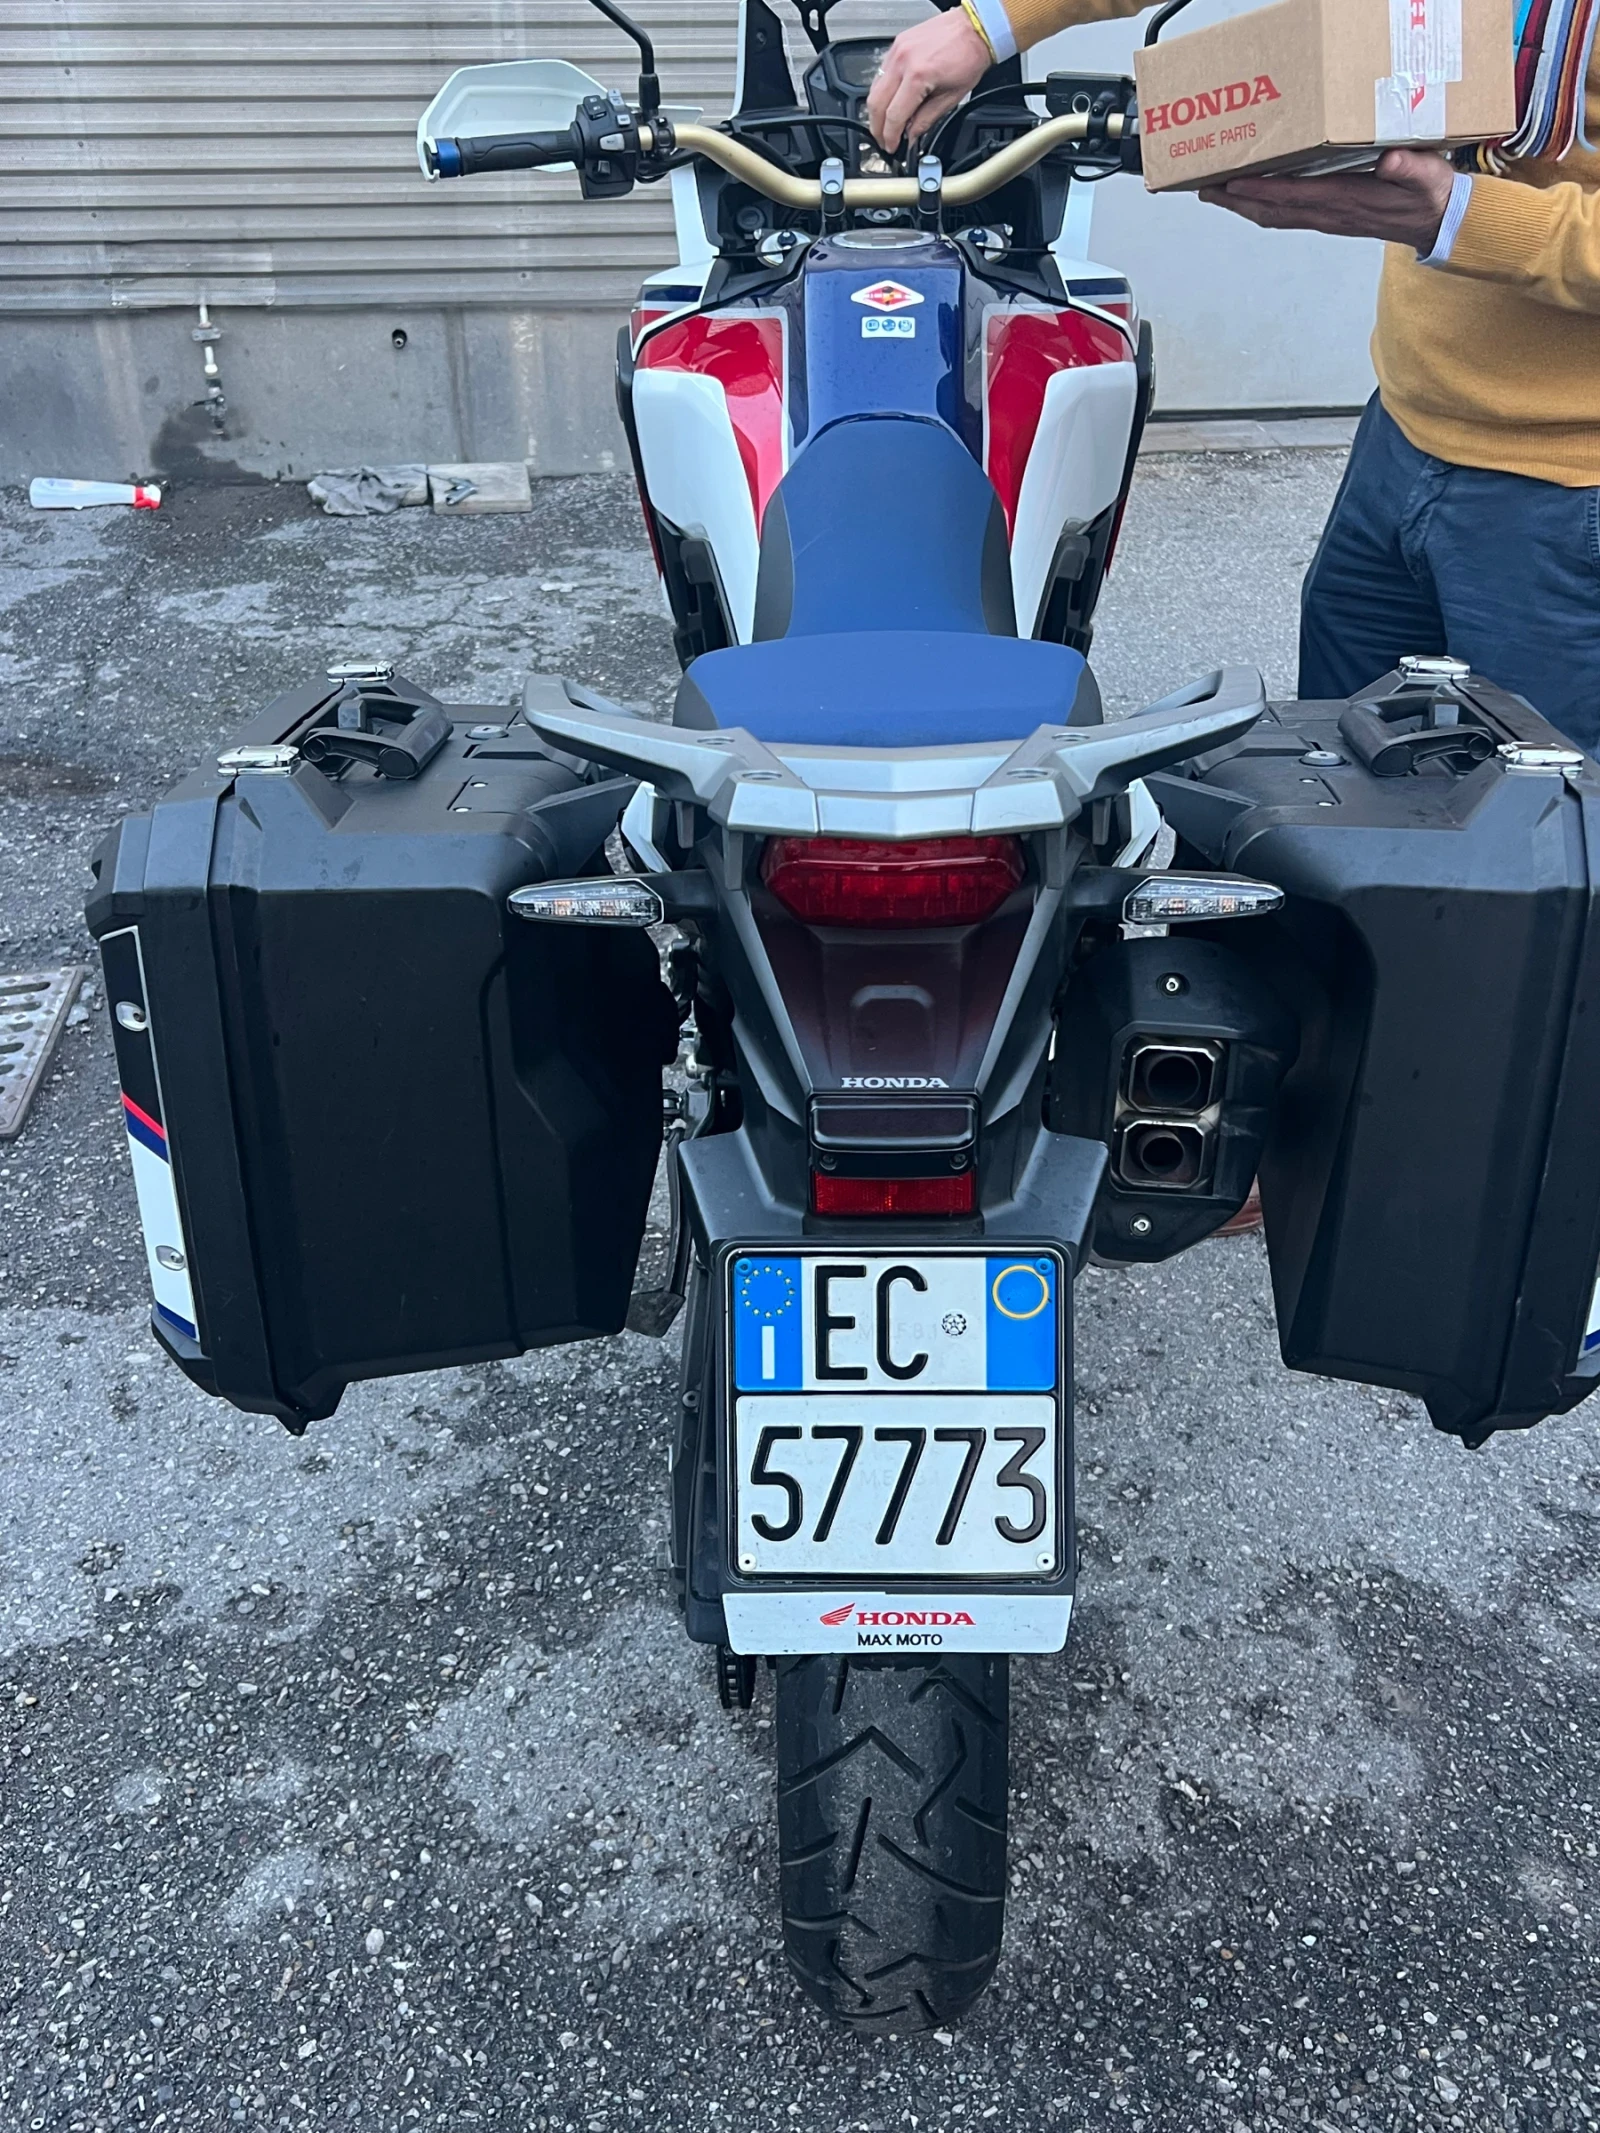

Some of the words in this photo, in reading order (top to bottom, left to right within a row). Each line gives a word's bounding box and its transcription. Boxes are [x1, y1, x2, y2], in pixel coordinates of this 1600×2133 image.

[1144, 75, 1281, 134] HONDA
[1169, 133, 1216, 158] GENUINE
[1220, 122, 1257, 145] PARTS
[841, 1077, 949, 1089] HONDA
[814, 1264, 929, 1380] EC
[750, 1425, 1047, 1545] 57773
[856, 1612, 976, 1626] HONDA
[857, 1632, 892, 1646] MAX
[896, 1633, 943, 1646] MOTO
